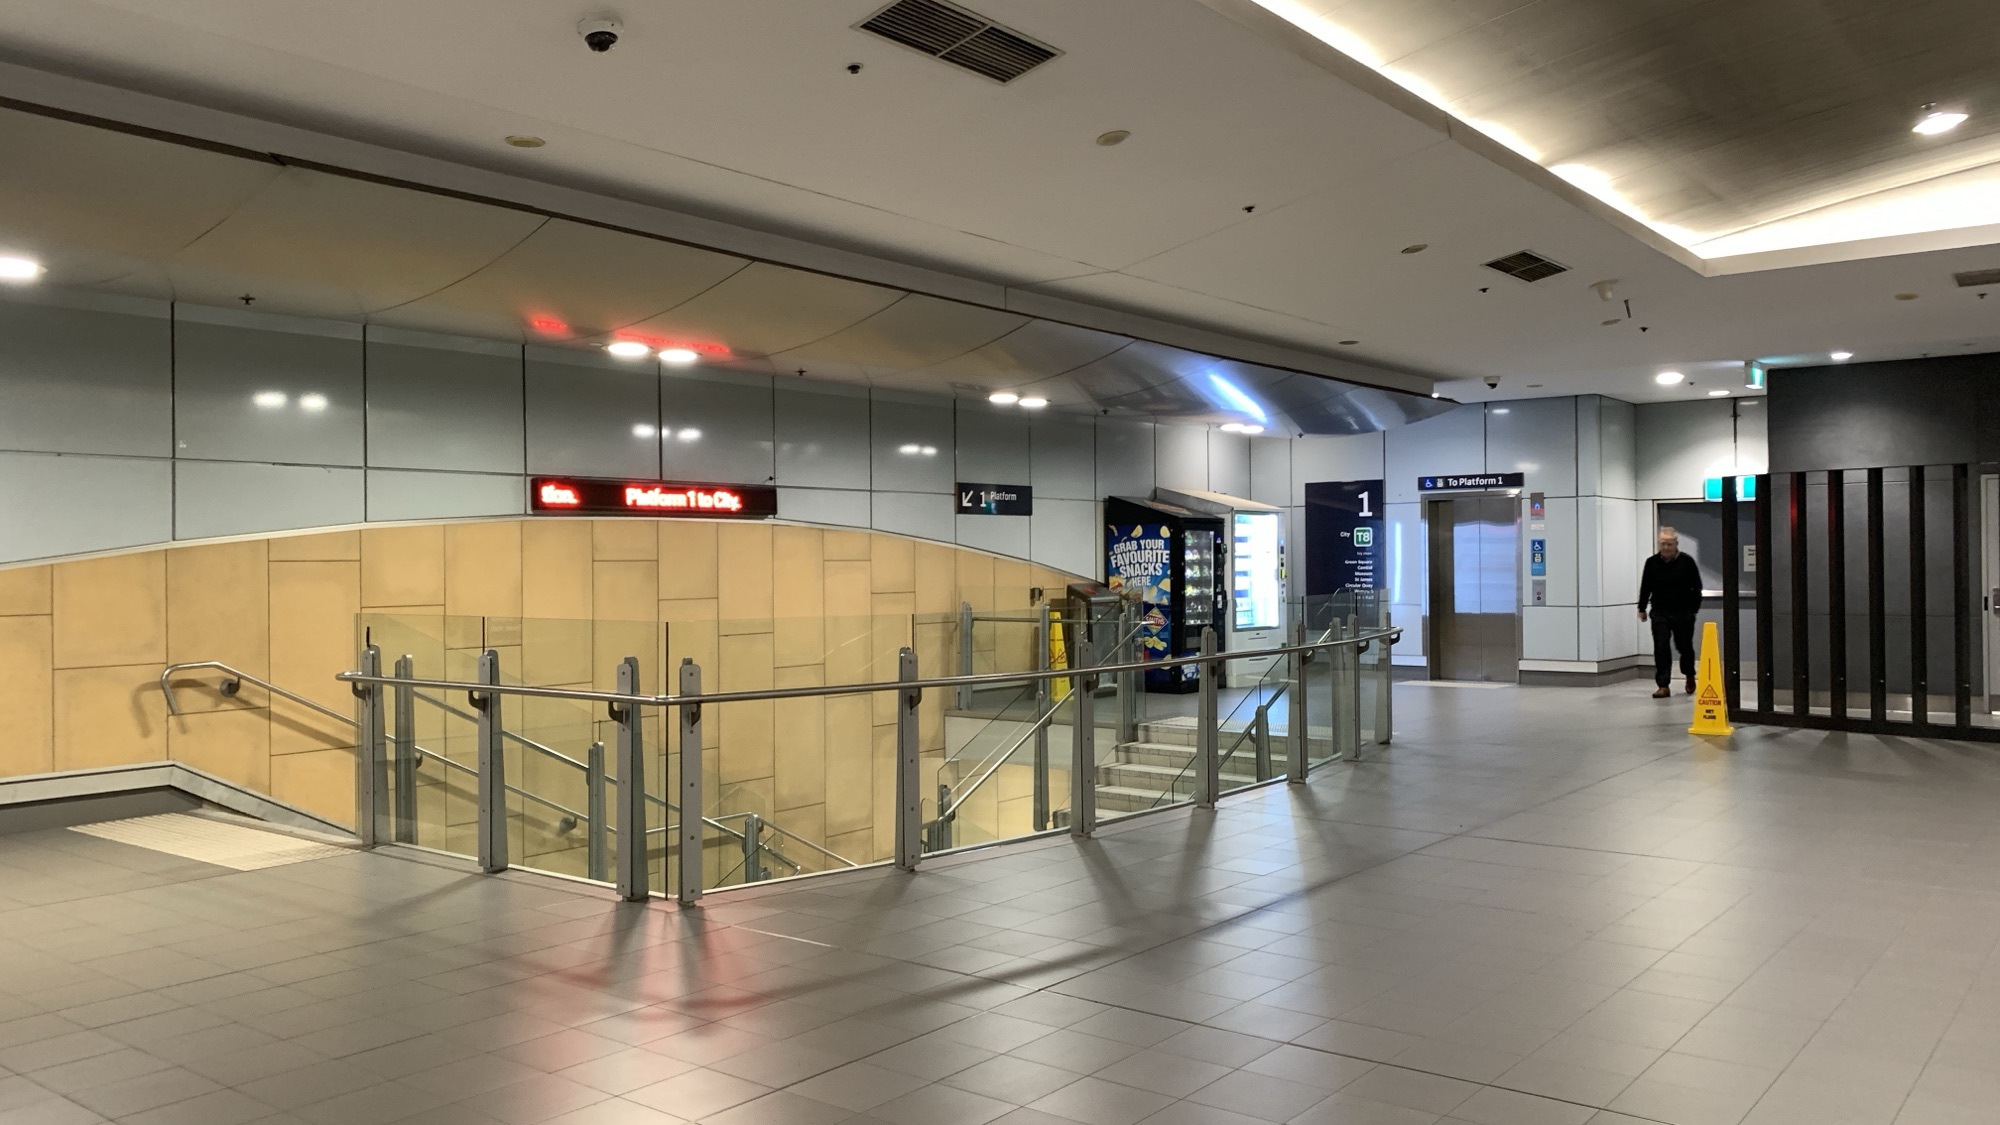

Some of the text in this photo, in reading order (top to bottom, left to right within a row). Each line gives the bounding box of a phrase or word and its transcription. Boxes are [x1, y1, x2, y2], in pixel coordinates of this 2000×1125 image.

[1448, 476, 1503, 487] To Platform 1
[625, 487, 687, 507] Platform
[687, 490, 696, 508] 1
[697, 491, 713, 508] to
[980, 491, 987, 508] 1
[990, 491, 1017, 501] Platform
[1358, 491, 1373, 517] 1
[1113, 539, 1165, 554] GRAB YOUR
[1110, 550, 1170, 569] FAVOURITE
[1119, 563, 1163, 578] SNACKS
[1132, 576, 1152, 587] HERE
